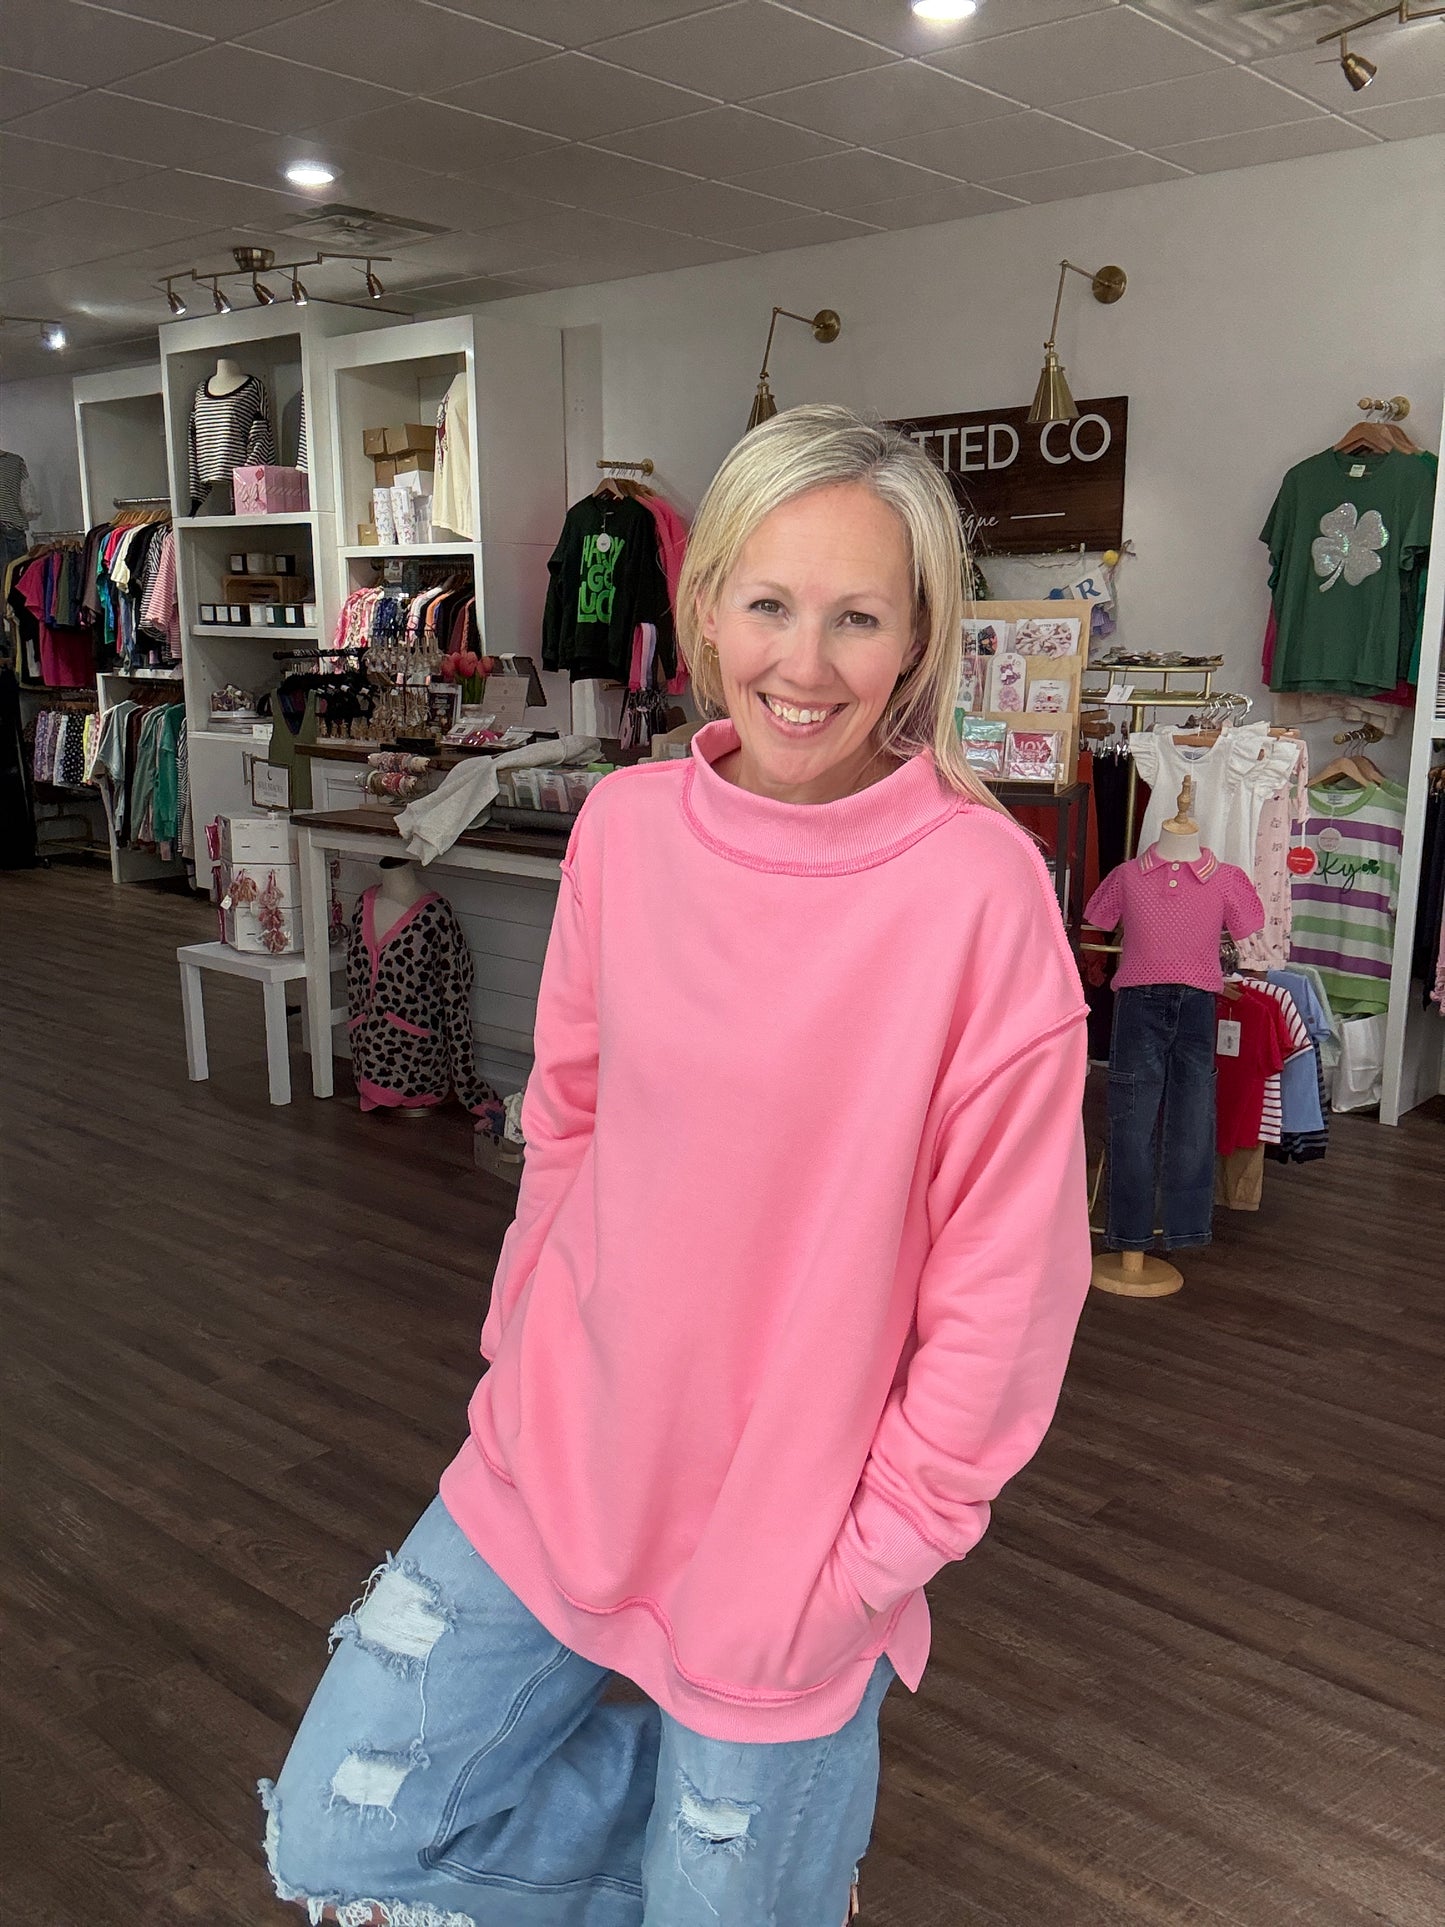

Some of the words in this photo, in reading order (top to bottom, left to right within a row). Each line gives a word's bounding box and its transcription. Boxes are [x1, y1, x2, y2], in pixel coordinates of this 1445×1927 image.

[1040, 414, 1111, 465] CO
[580, 534, 625, 575] HAY
[1076, 578, 1101, 600] R
